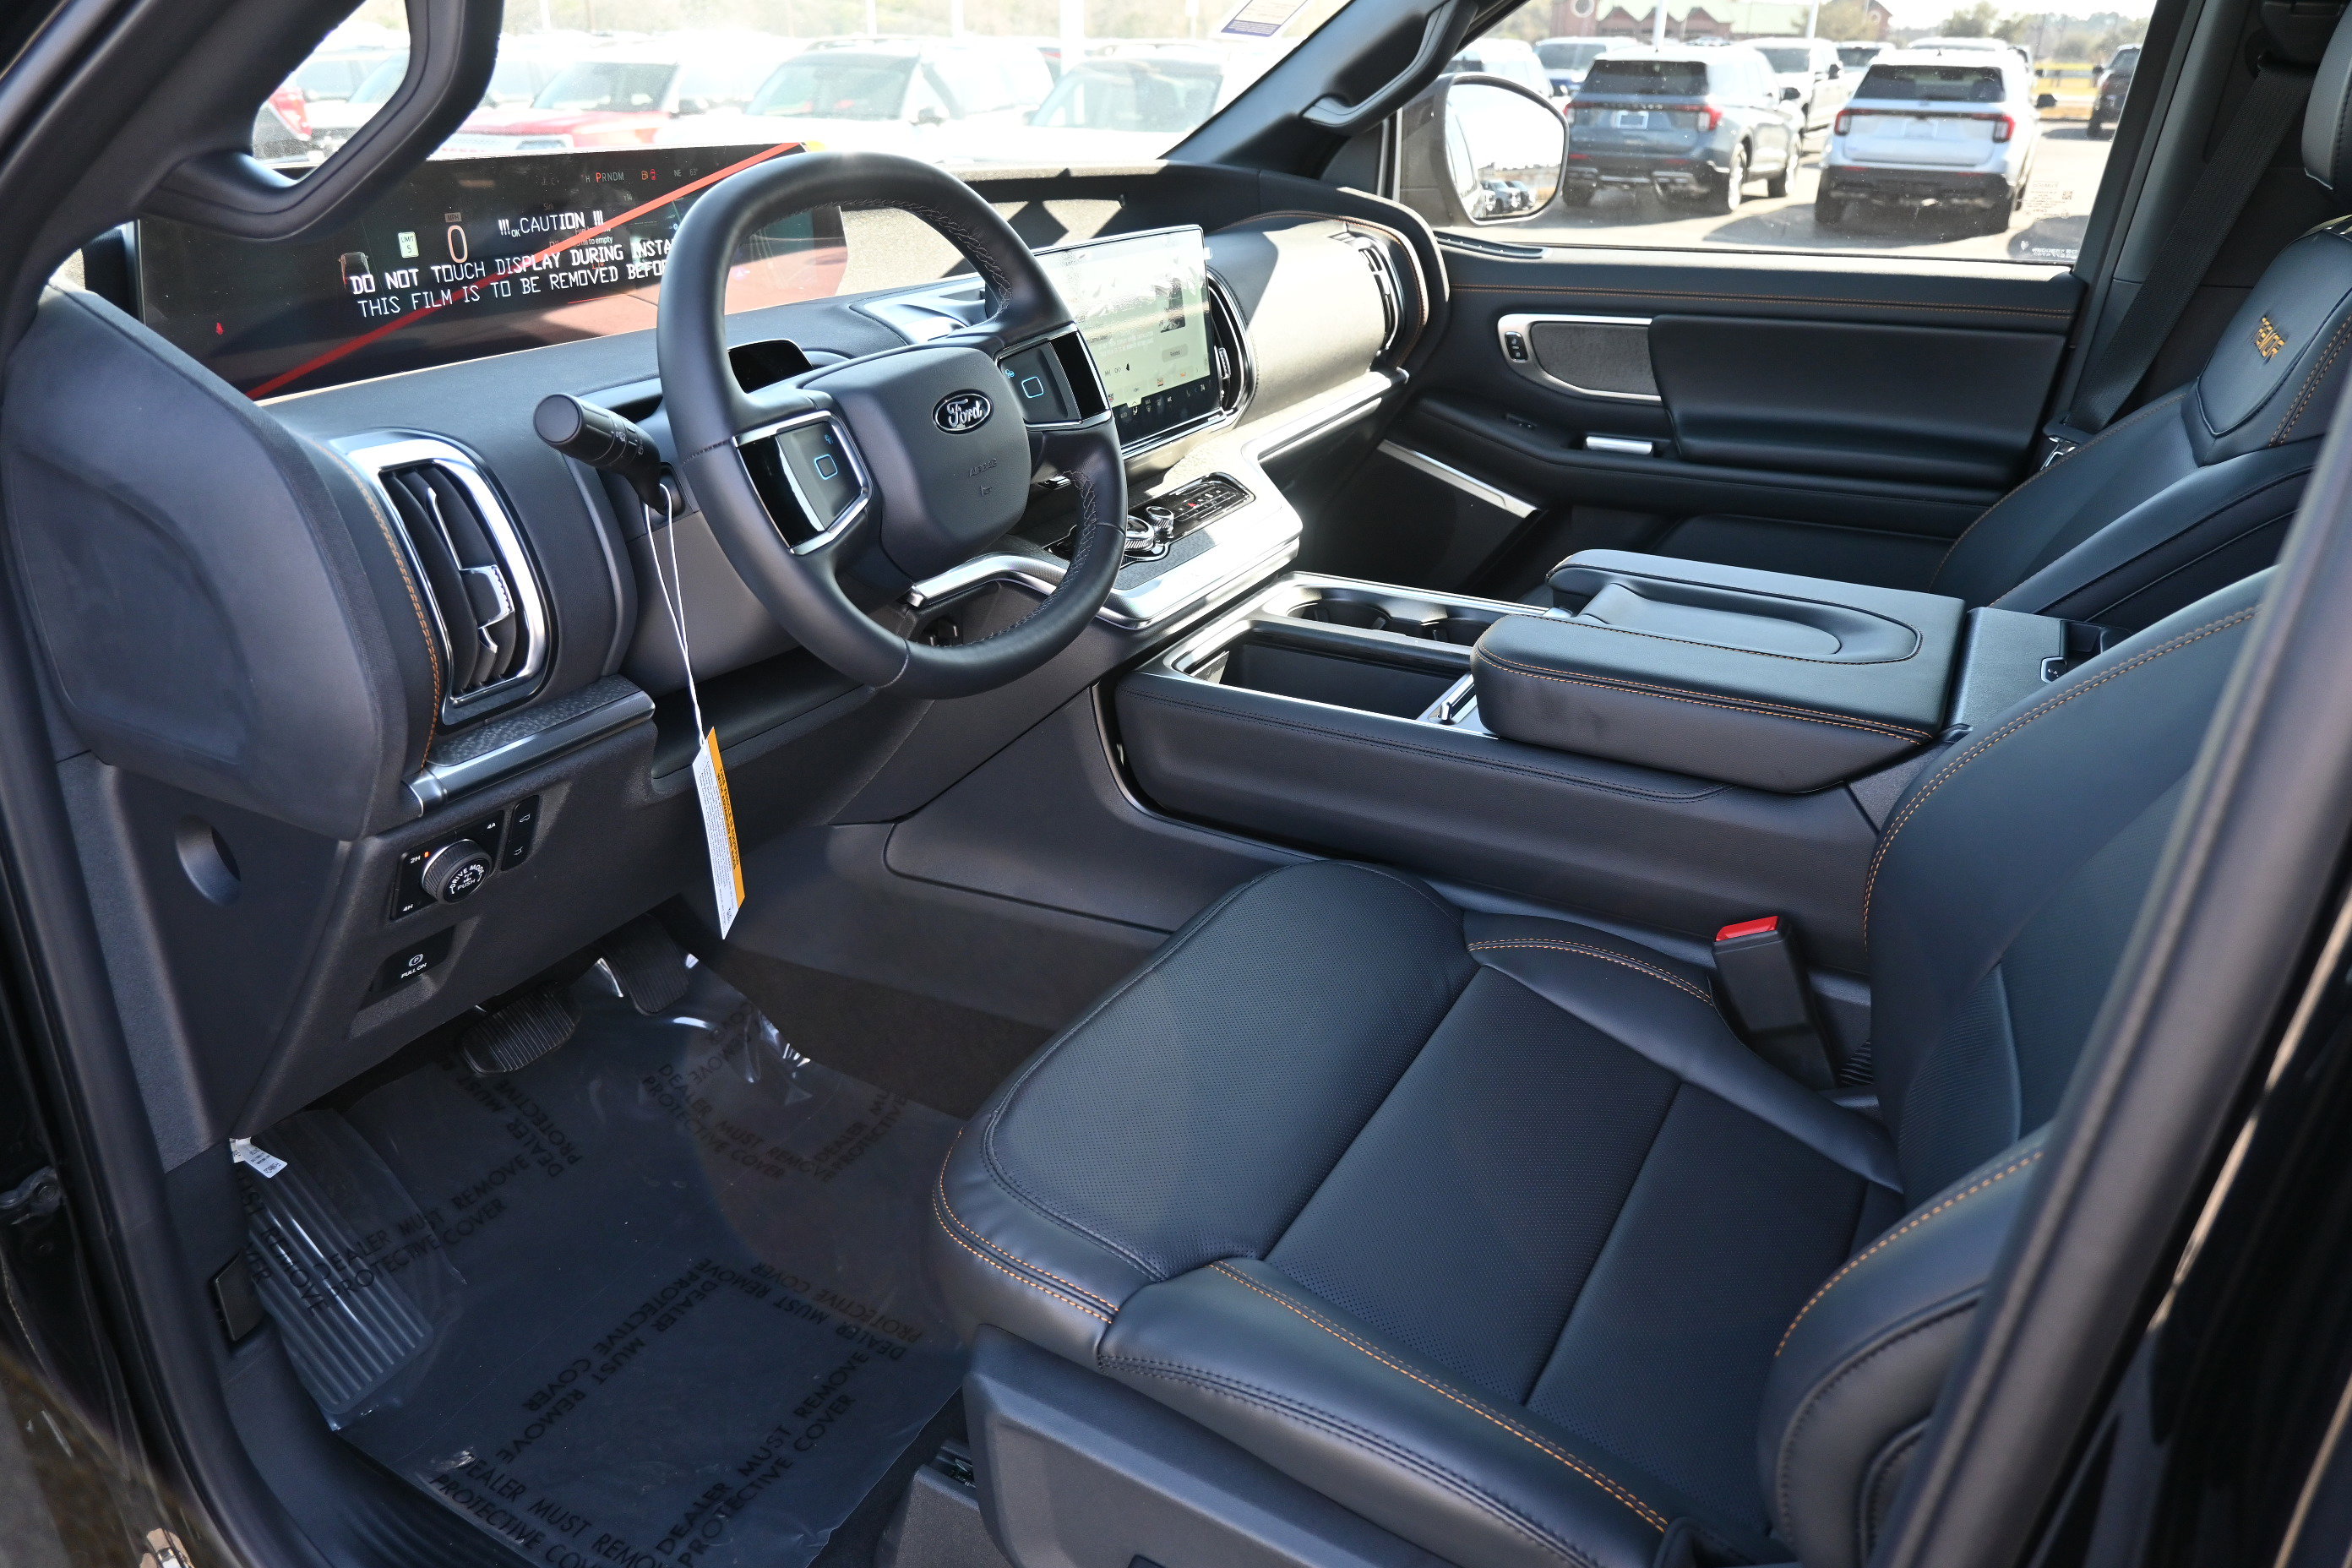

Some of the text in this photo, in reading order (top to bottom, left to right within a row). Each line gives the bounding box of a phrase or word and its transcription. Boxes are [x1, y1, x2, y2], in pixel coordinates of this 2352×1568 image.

[520, 211, 585, 234] CAUTION
[349, 274, 376, 295] DO
[384, 268, 419, 290] NOT
[430, 261, 486, 283] TOUCH
[495, 252, 561, 275] DISPLAY
[570, 244, 623, 266] DURING
[357, 296, 401, 318] THIS
[411, 289, 453, 310] FILM
[462, 285, 481, 303] IS
[490, 280, 512, 298] TO
[520, 276, 541, 295] BE
[549, 267, 618, 291] REMOVED
[946, 398, 983, 427] Ford
[410, 855, 421, 863] 2H
[449, 863, 485, 890] DRIVE MODE
[457, 879, 476, 890] PUSH
[402, 903, 413, 912] 4H
[400, 962, 427, 978] PULL ON
[455, 1075, 565, 1179] DEALER MUST
[493, 1076, 583, 1166] PROTECTIVE
[642, 1075, 786, 1179] PROTECTIVE COVER
[658, 1063, 713, 1118] DEALER
[716, 1119, 765, 1148] MUST
[396, 1207, 445, 1237] MUST
[451, 1154, 531, 1211] REMOVE
[443, 1198, 507, 1245] COVER
[520, 1270, 701, 1412] PROTECTIVE COVER
[698, 1257, 908, 1361] DEALER MUST REMOVE
[750, 1261, 923, 1344] PROTECTIVE COVER
[495, 1279, 718, 1464] DEALER MUST REMOVE
[656, 1351, 871, 1556] DEALER MUST REMOVE
[677, 1394, 856, 1568] PROTECTIVE COVER
[430, 1473, 547, 1550] PROTECTIVE
[527, 1498, 593, 1538] MUST
